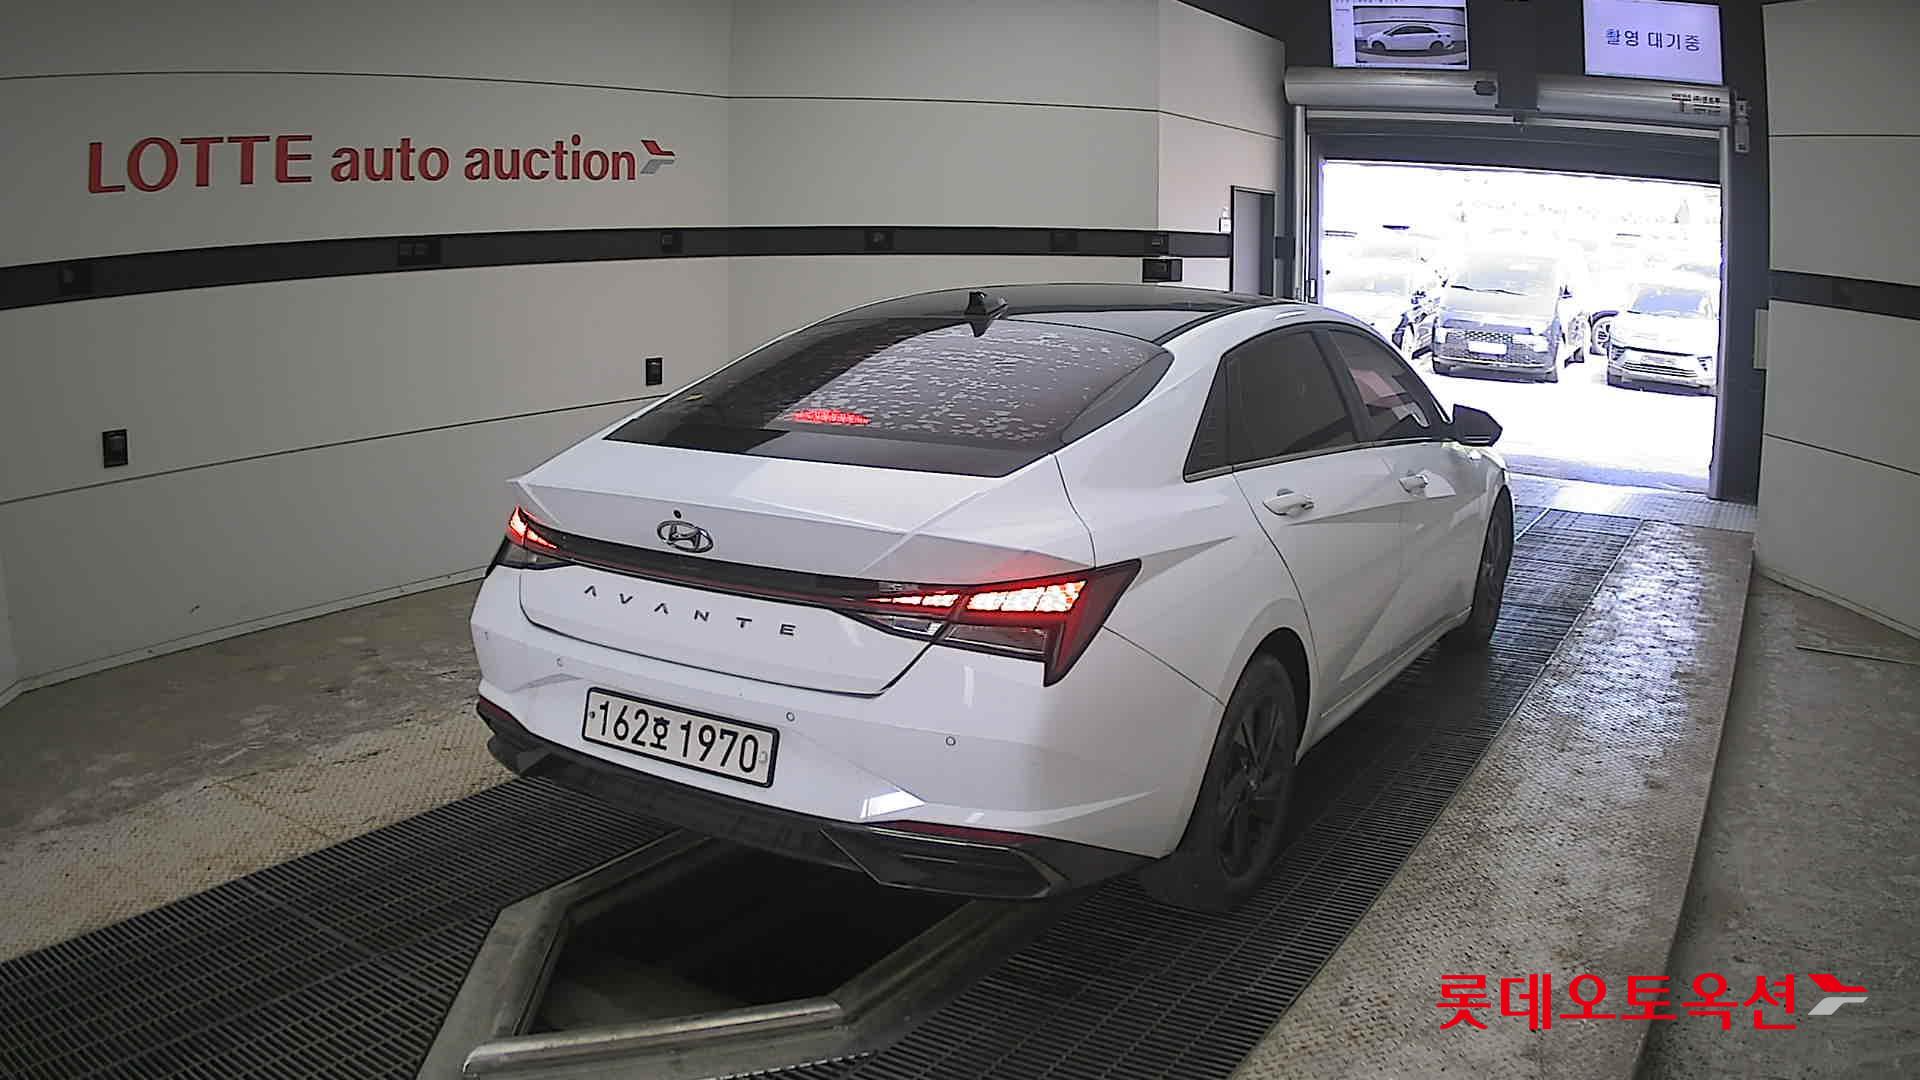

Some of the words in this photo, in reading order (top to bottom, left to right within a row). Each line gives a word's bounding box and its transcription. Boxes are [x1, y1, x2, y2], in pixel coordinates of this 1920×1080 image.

[87, 134, 313, 194] LOTTE
[330, 137, 450, 182] auto
[463, 133, 637, 182] auction
[584, 584, 796, 636] AVANTE
[599, 700, 671, 751] 162호
[679, 720, 760, 773] 1970
